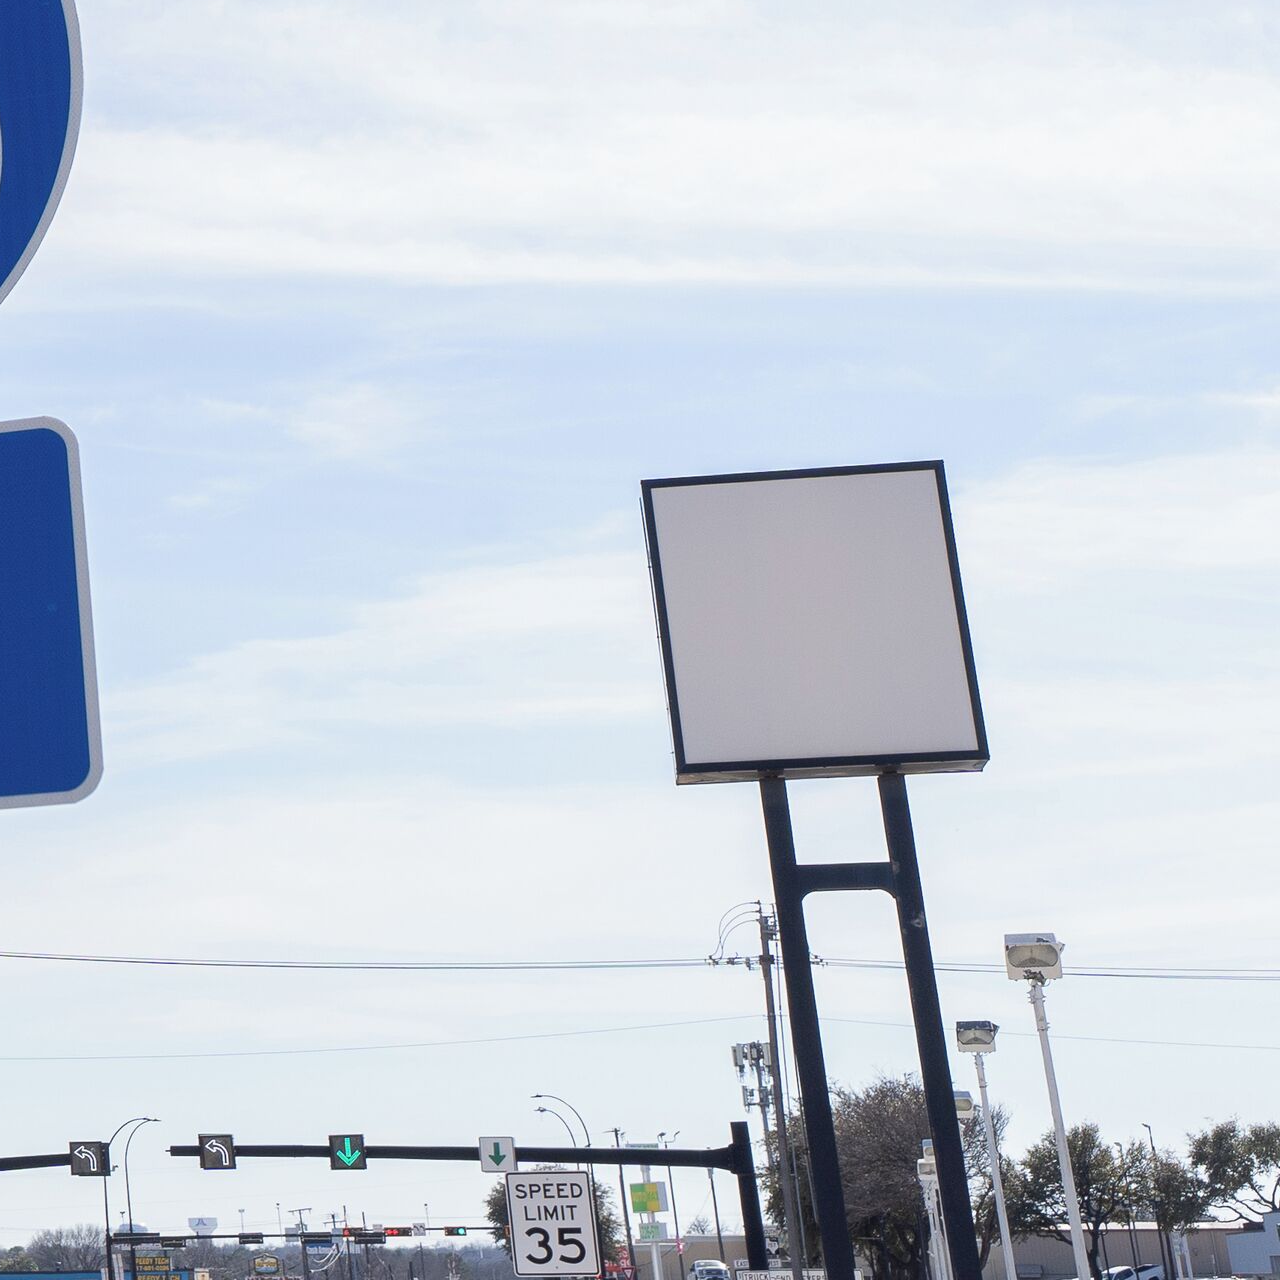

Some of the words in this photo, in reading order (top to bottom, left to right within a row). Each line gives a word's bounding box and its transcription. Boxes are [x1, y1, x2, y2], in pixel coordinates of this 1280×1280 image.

[515, 1182, 583, 1199] SPEED
[524, 1205, 577, 1221] LIMIT
[525, 1226, 586, 1265] 35
